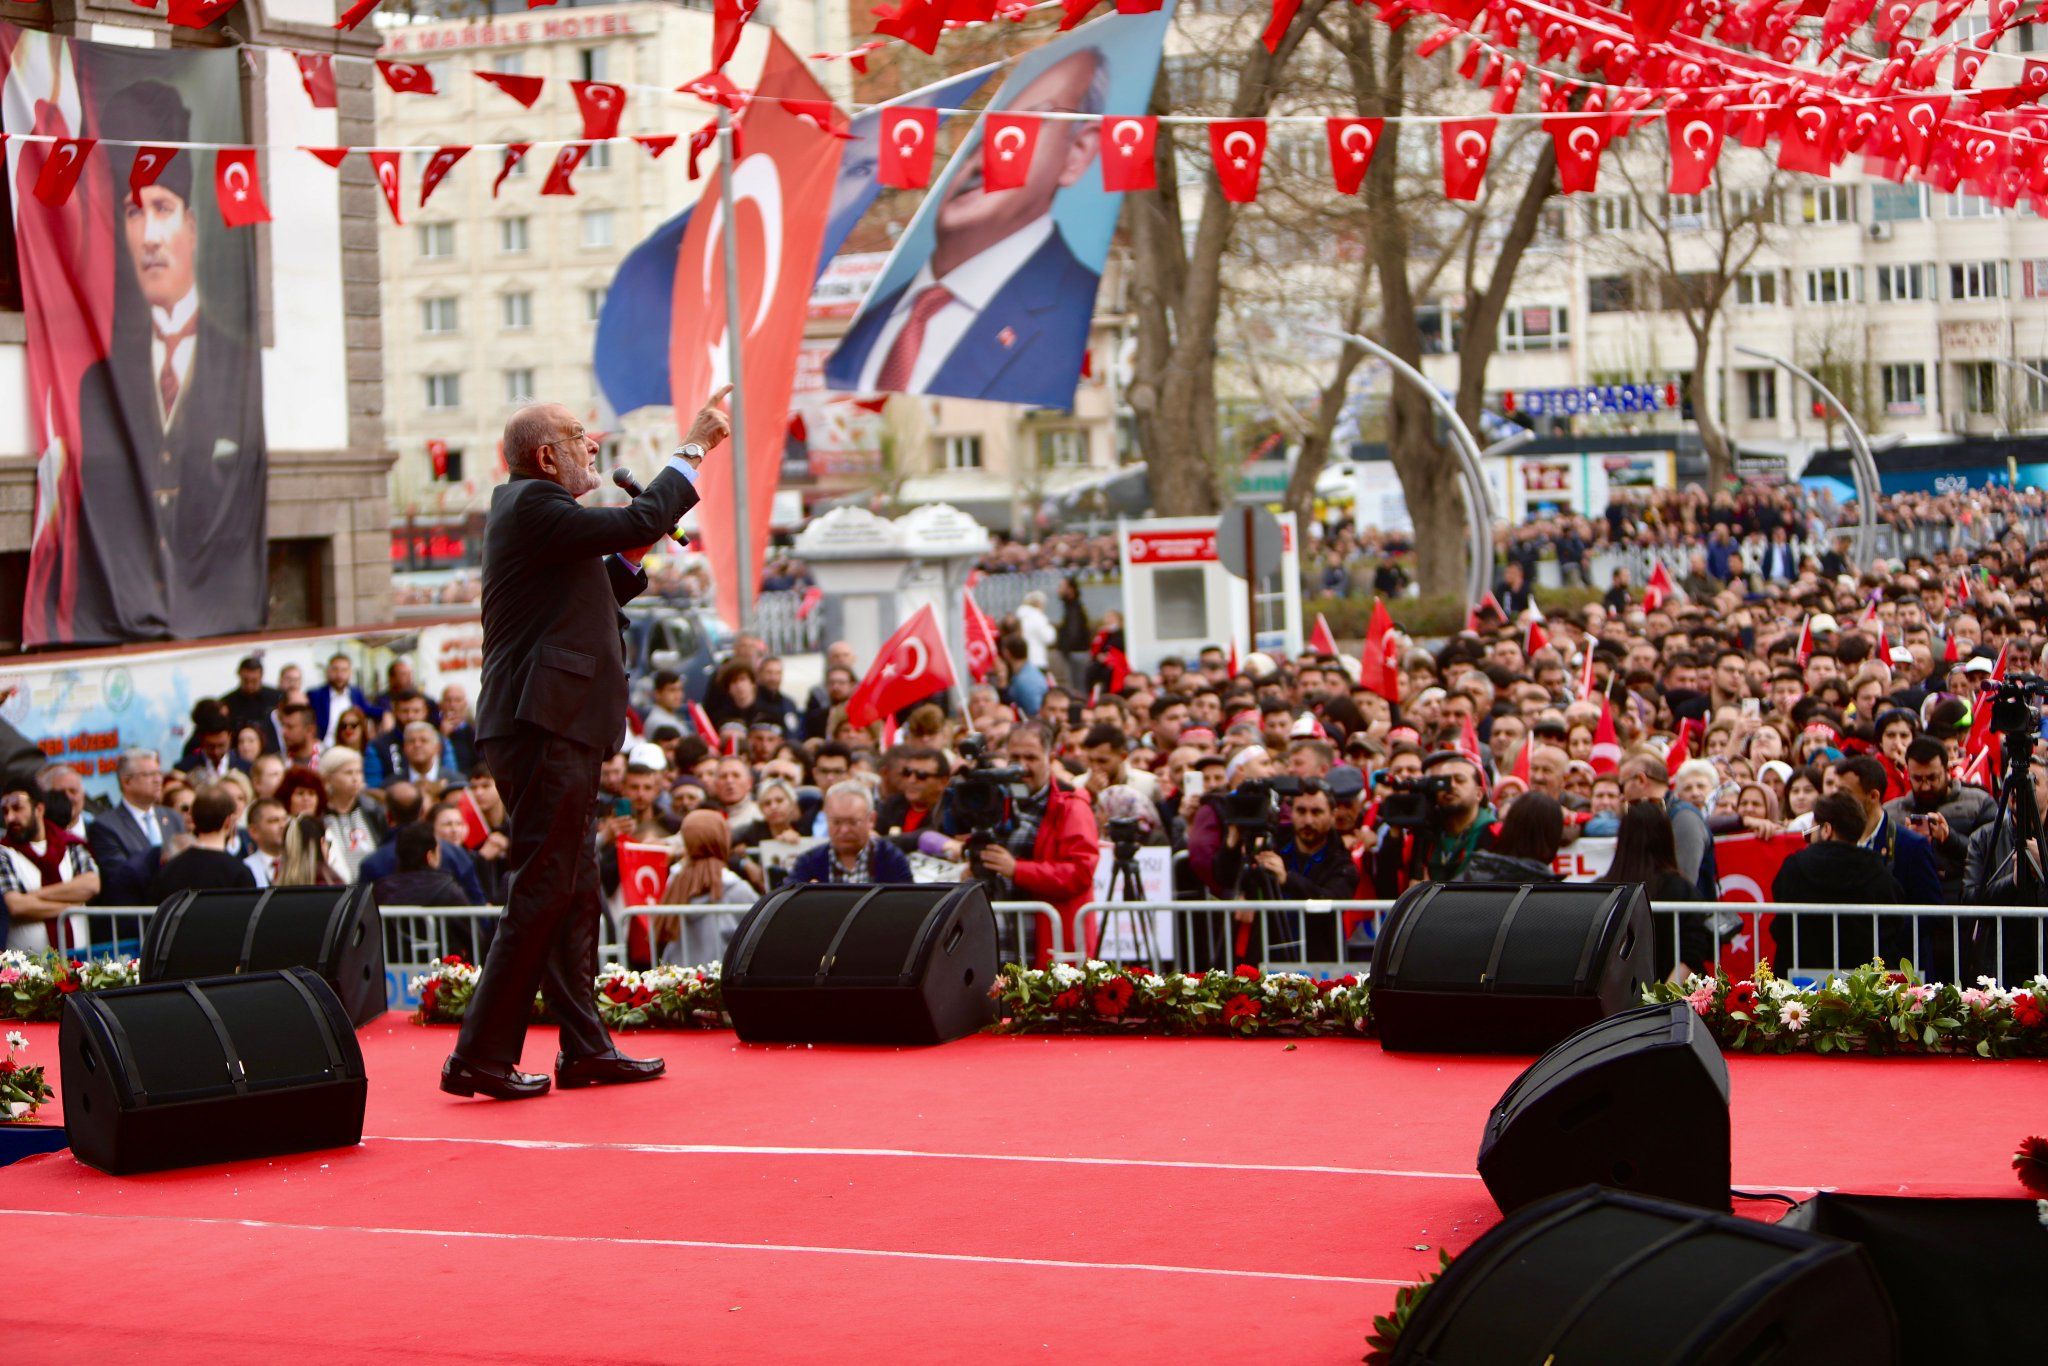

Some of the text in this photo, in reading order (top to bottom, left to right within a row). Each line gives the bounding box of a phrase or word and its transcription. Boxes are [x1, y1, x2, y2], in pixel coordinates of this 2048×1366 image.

[419, 22, 530, 49] MARBLE
[543, 14, 635, 38] HOTEL
[1524, 384, 1659, 417] OTOPARK
